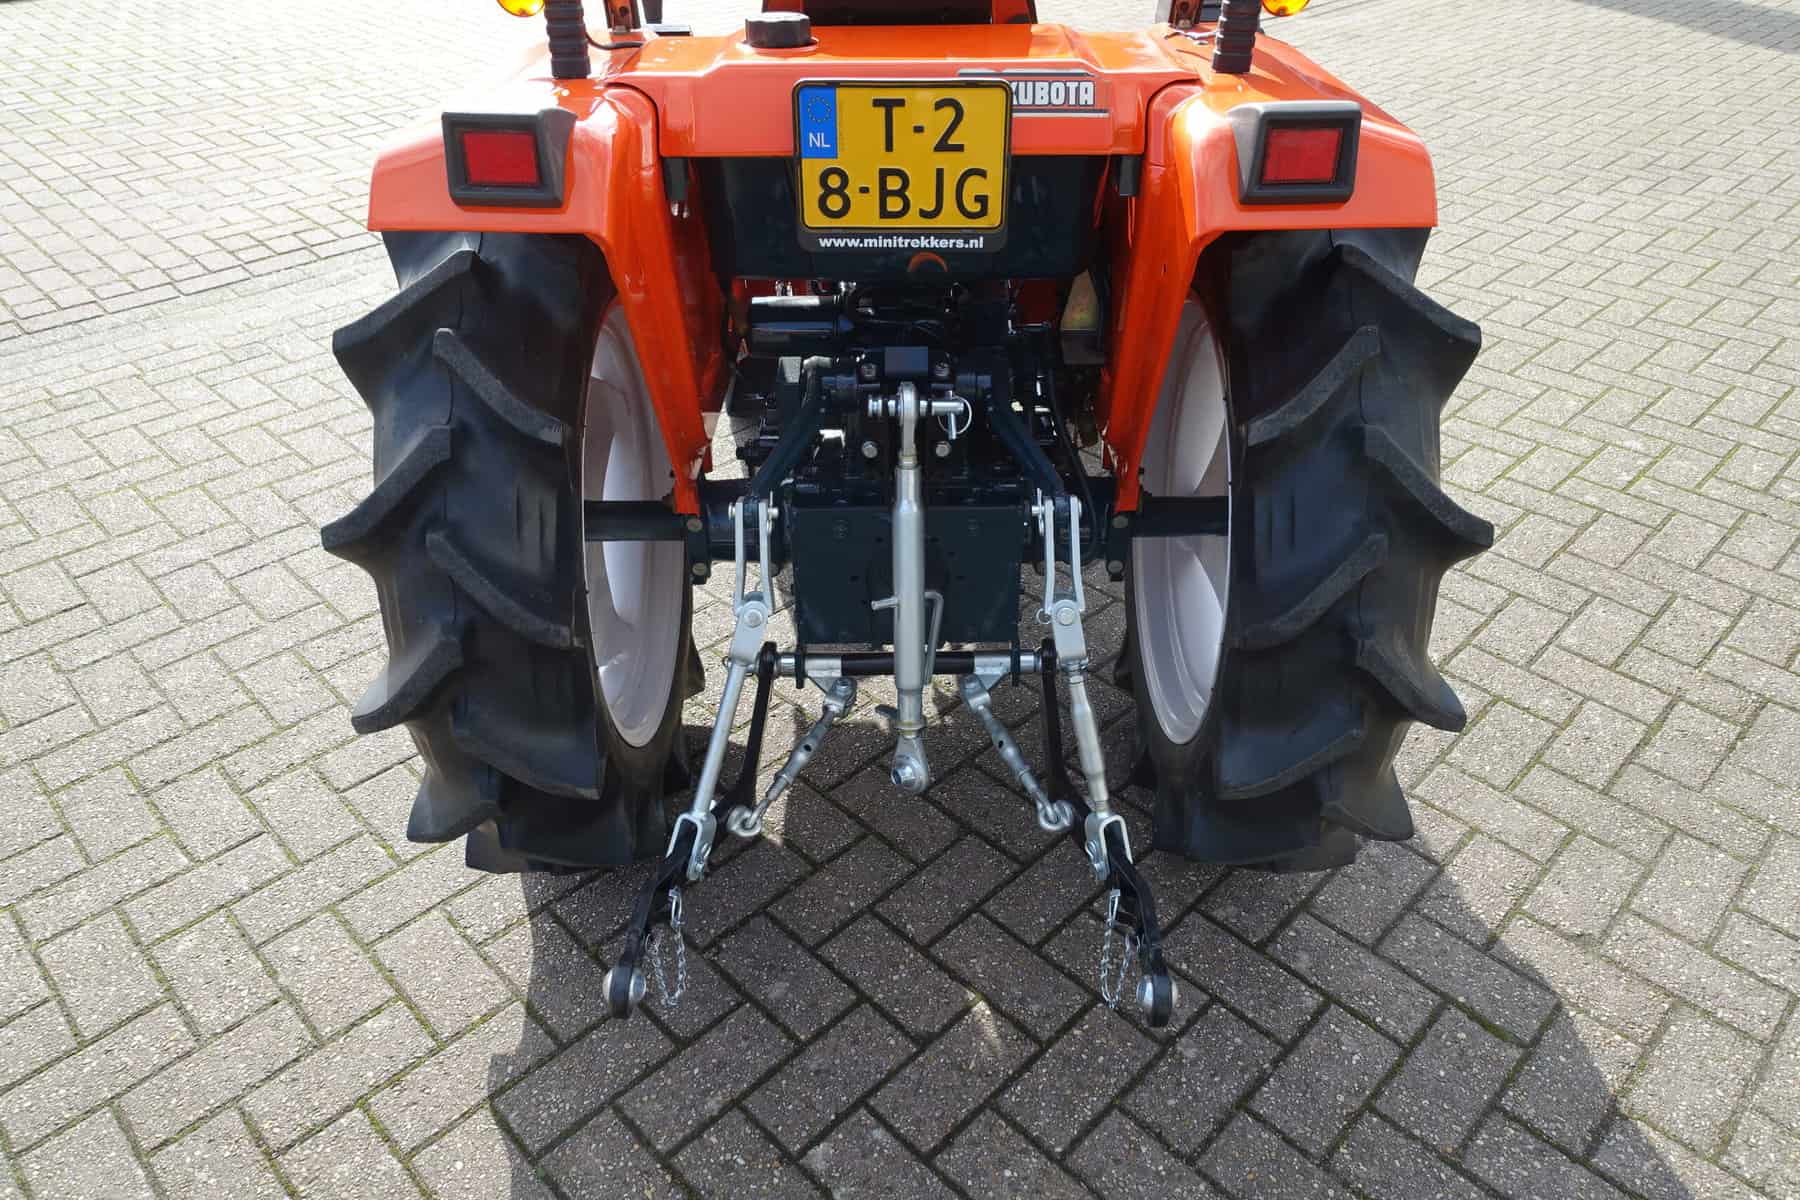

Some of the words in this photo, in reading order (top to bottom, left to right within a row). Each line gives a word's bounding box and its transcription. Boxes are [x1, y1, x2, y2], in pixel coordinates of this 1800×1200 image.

[808, 131, 832, 149] NL
[871, 97, 966, 153] T-2
[817, 166, 990, 220] 8-BJG
[818, 235, 984, 249] www.minitrekkers.nl
